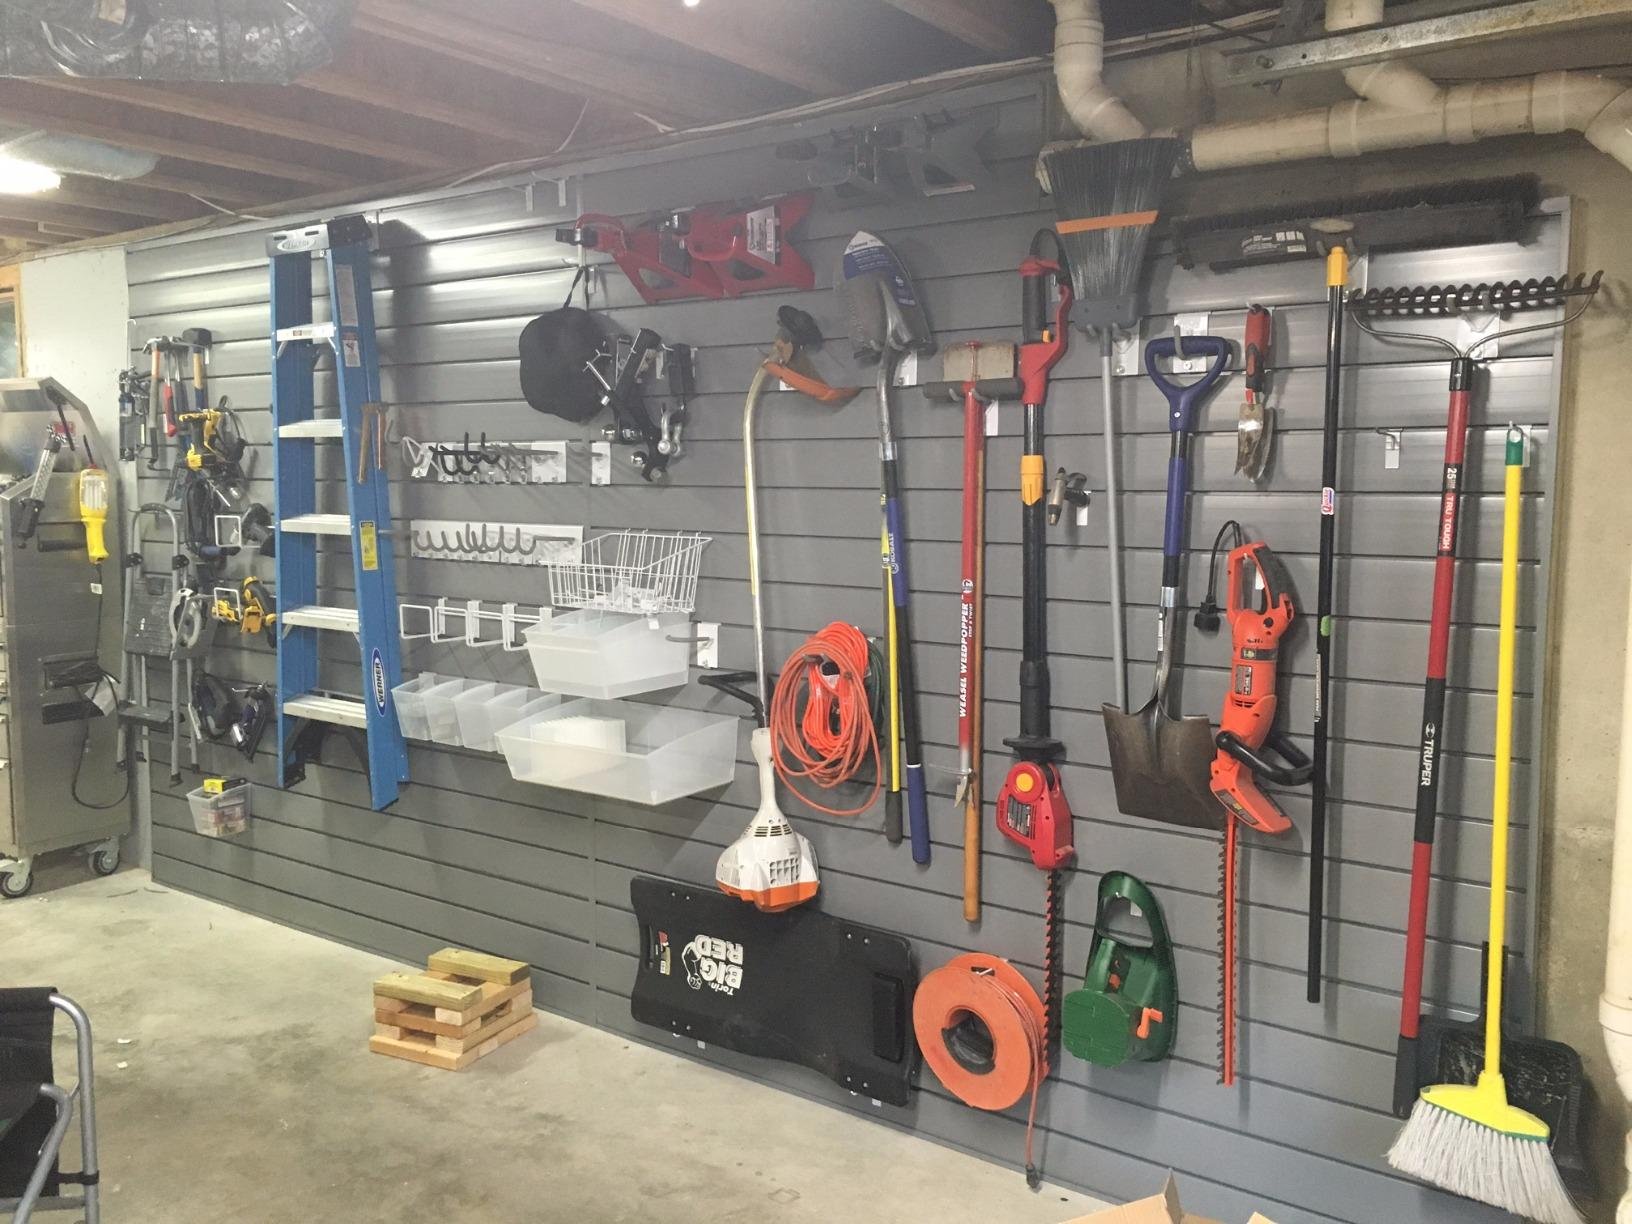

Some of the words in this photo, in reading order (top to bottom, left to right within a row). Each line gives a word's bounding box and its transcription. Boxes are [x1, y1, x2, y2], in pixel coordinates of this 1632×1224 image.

[1447, 467, 1457, 479] 25
[1445, 495, 1454, 515] TRU
[1443, 517, 1452, 549] TOUGH
[960, 603, 969, 674] WEEDPOPPER
[375, 663, 384, 702] WERNER
[959, 677, 967, 718] WEASEL
[1421, 739, 1434, 786] TRUPER
[694, 934, 744, 966] RED
[699, 956, 744, 989] BIG
[710, 982, 734, 996] Torin
